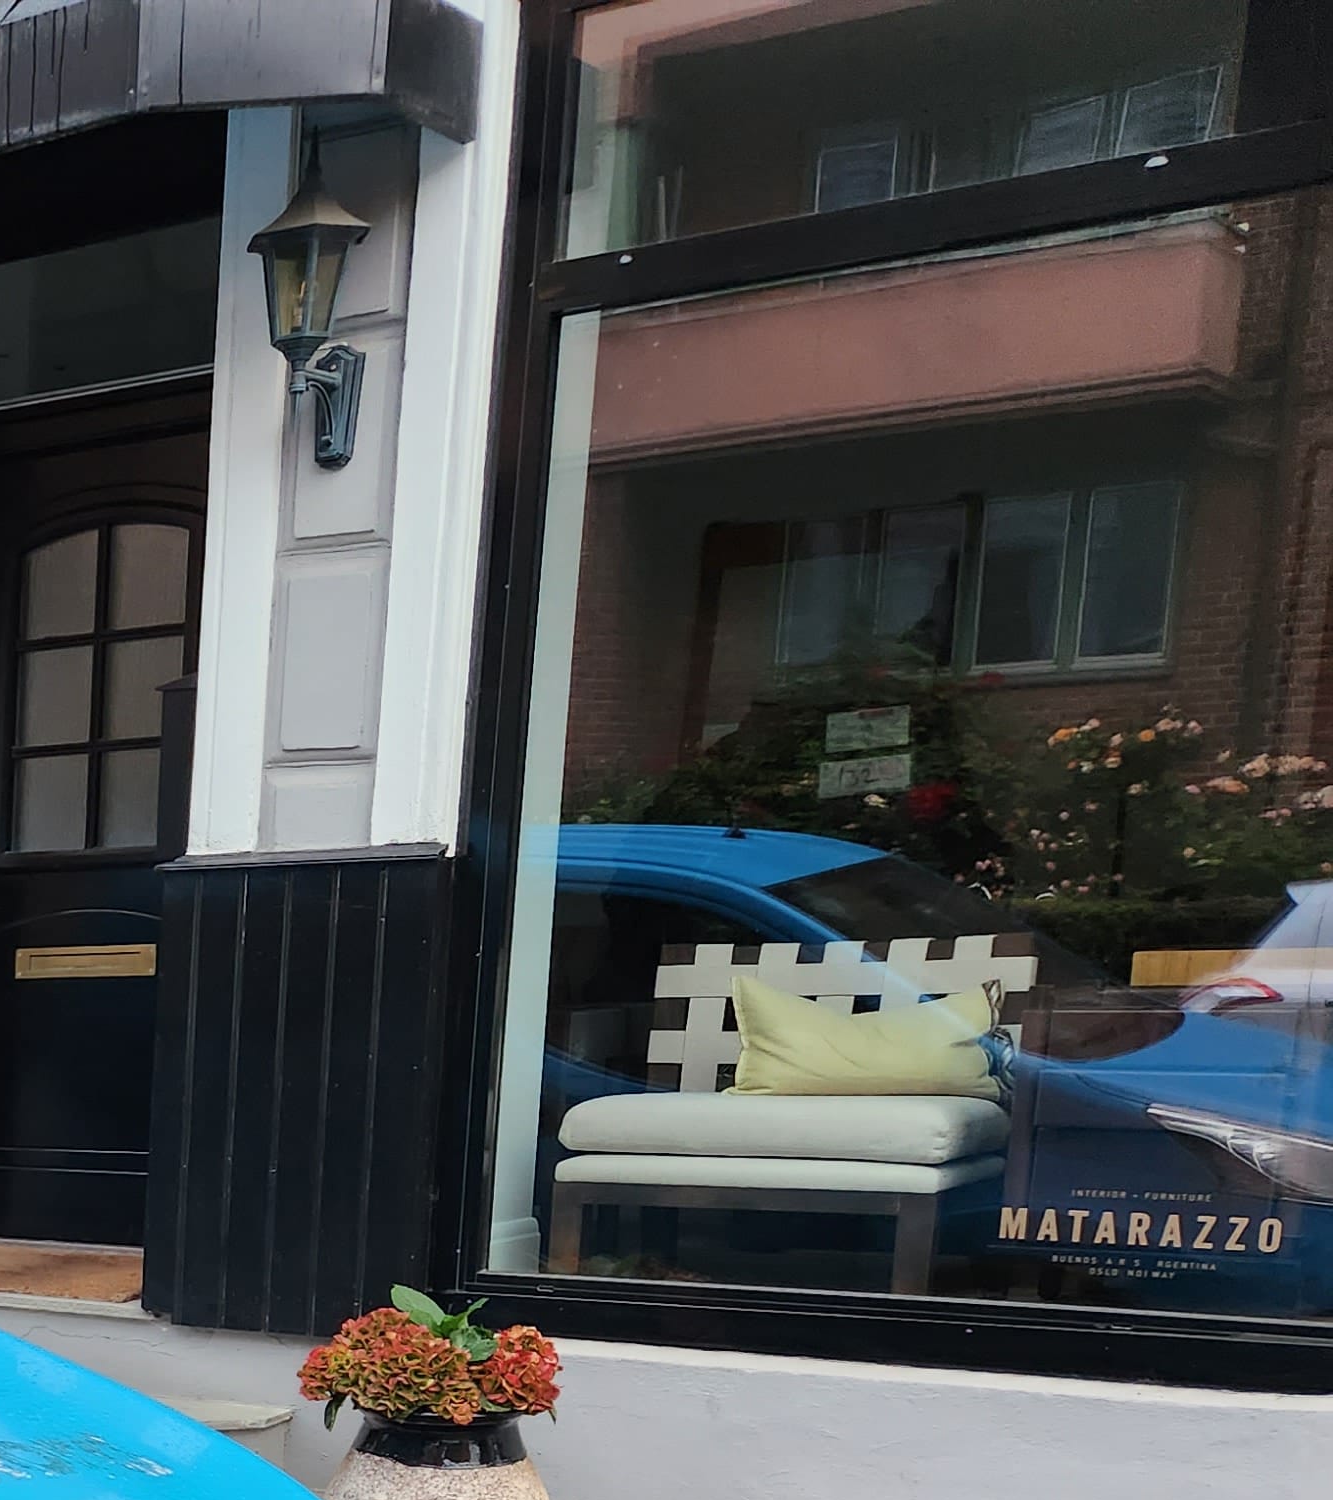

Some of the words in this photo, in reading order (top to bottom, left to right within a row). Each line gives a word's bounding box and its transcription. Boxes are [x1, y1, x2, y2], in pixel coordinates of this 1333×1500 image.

[1071, 1189, 1127, 1199] INTERIOR
[1144, 1191, 1213, 1202] FURNITURE
[998, 1206, 1283, 1253] MATARAZZO
[1051, 1254, 1098, 1265] BUENOS
[1105, 1257, 1141, 1267] ARS
[1149, 1259, 1217, 1271] RGENTINA
[1088, 1267, 1120, 1277] OSLO
